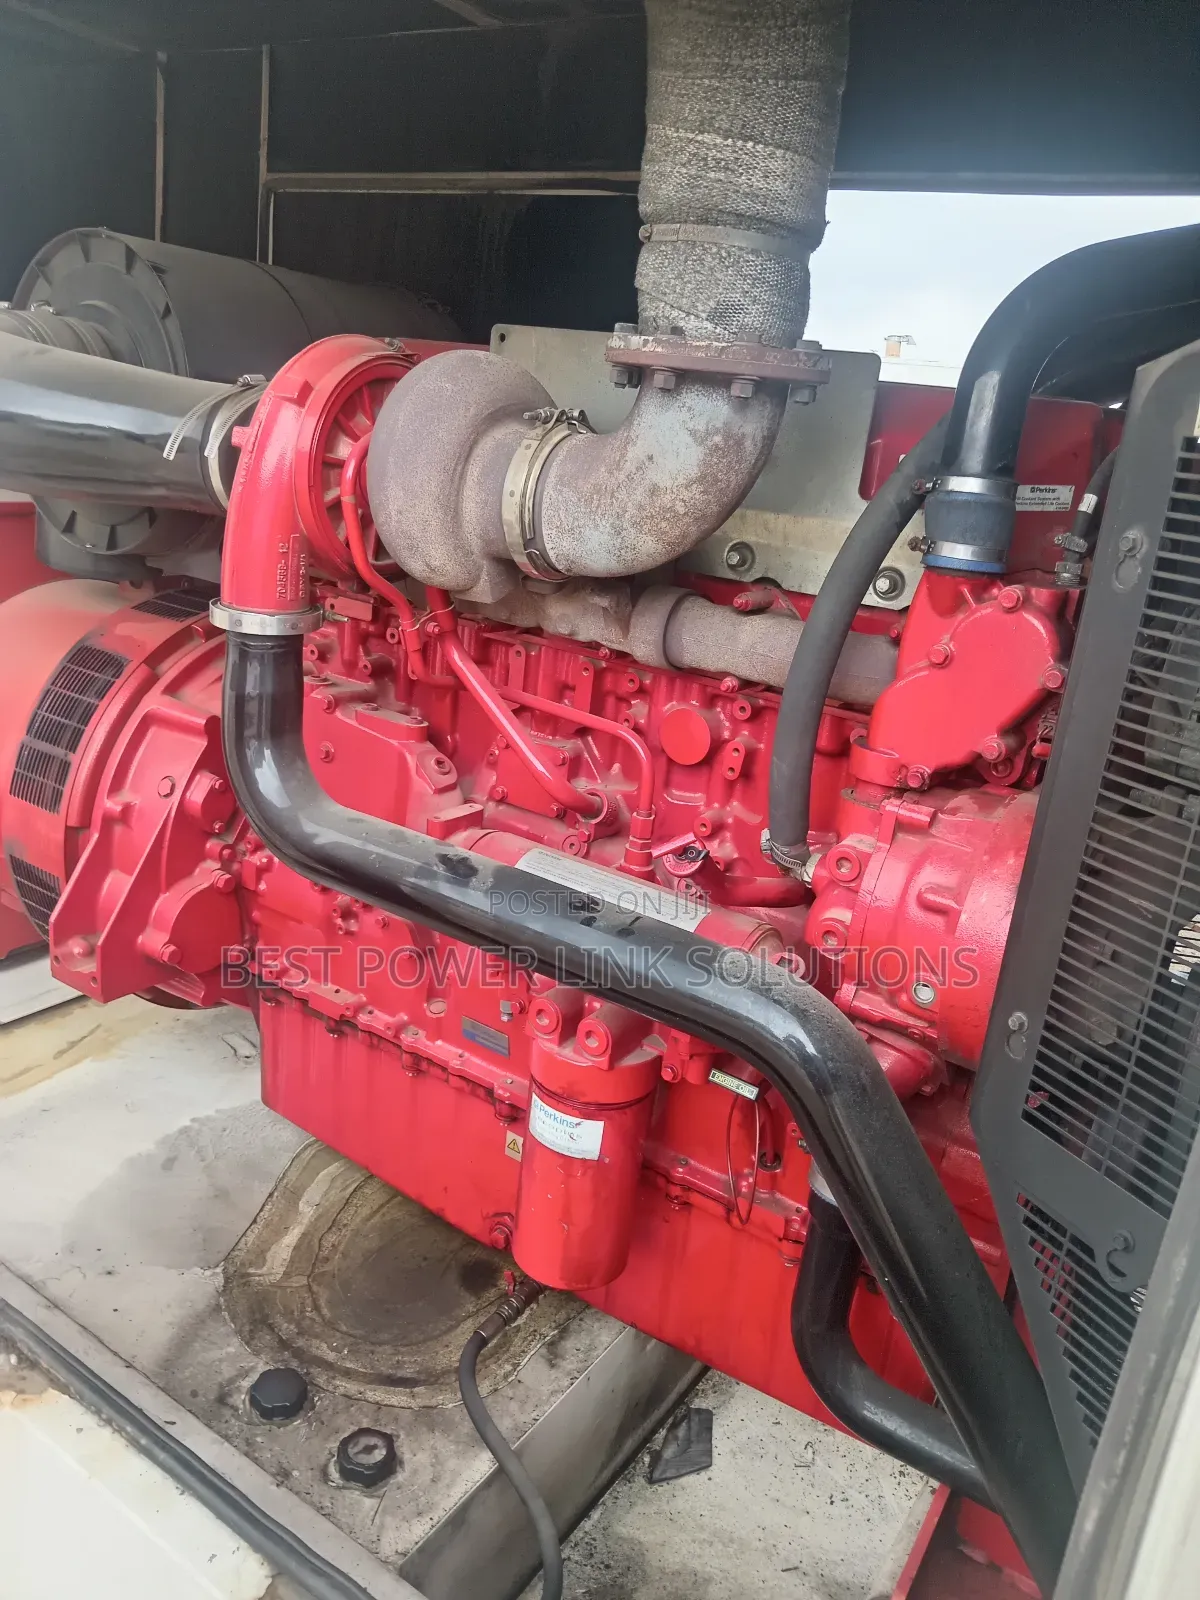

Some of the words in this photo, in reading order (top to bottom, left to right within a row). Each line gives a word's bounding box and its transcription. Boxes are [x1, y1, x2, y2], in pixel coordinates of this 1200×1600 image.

[714, 1072, 740, 1090] ENGINE
[738, 1083, 751, 1095] OIL
[539, 1106, 577, 1129] Perkins
